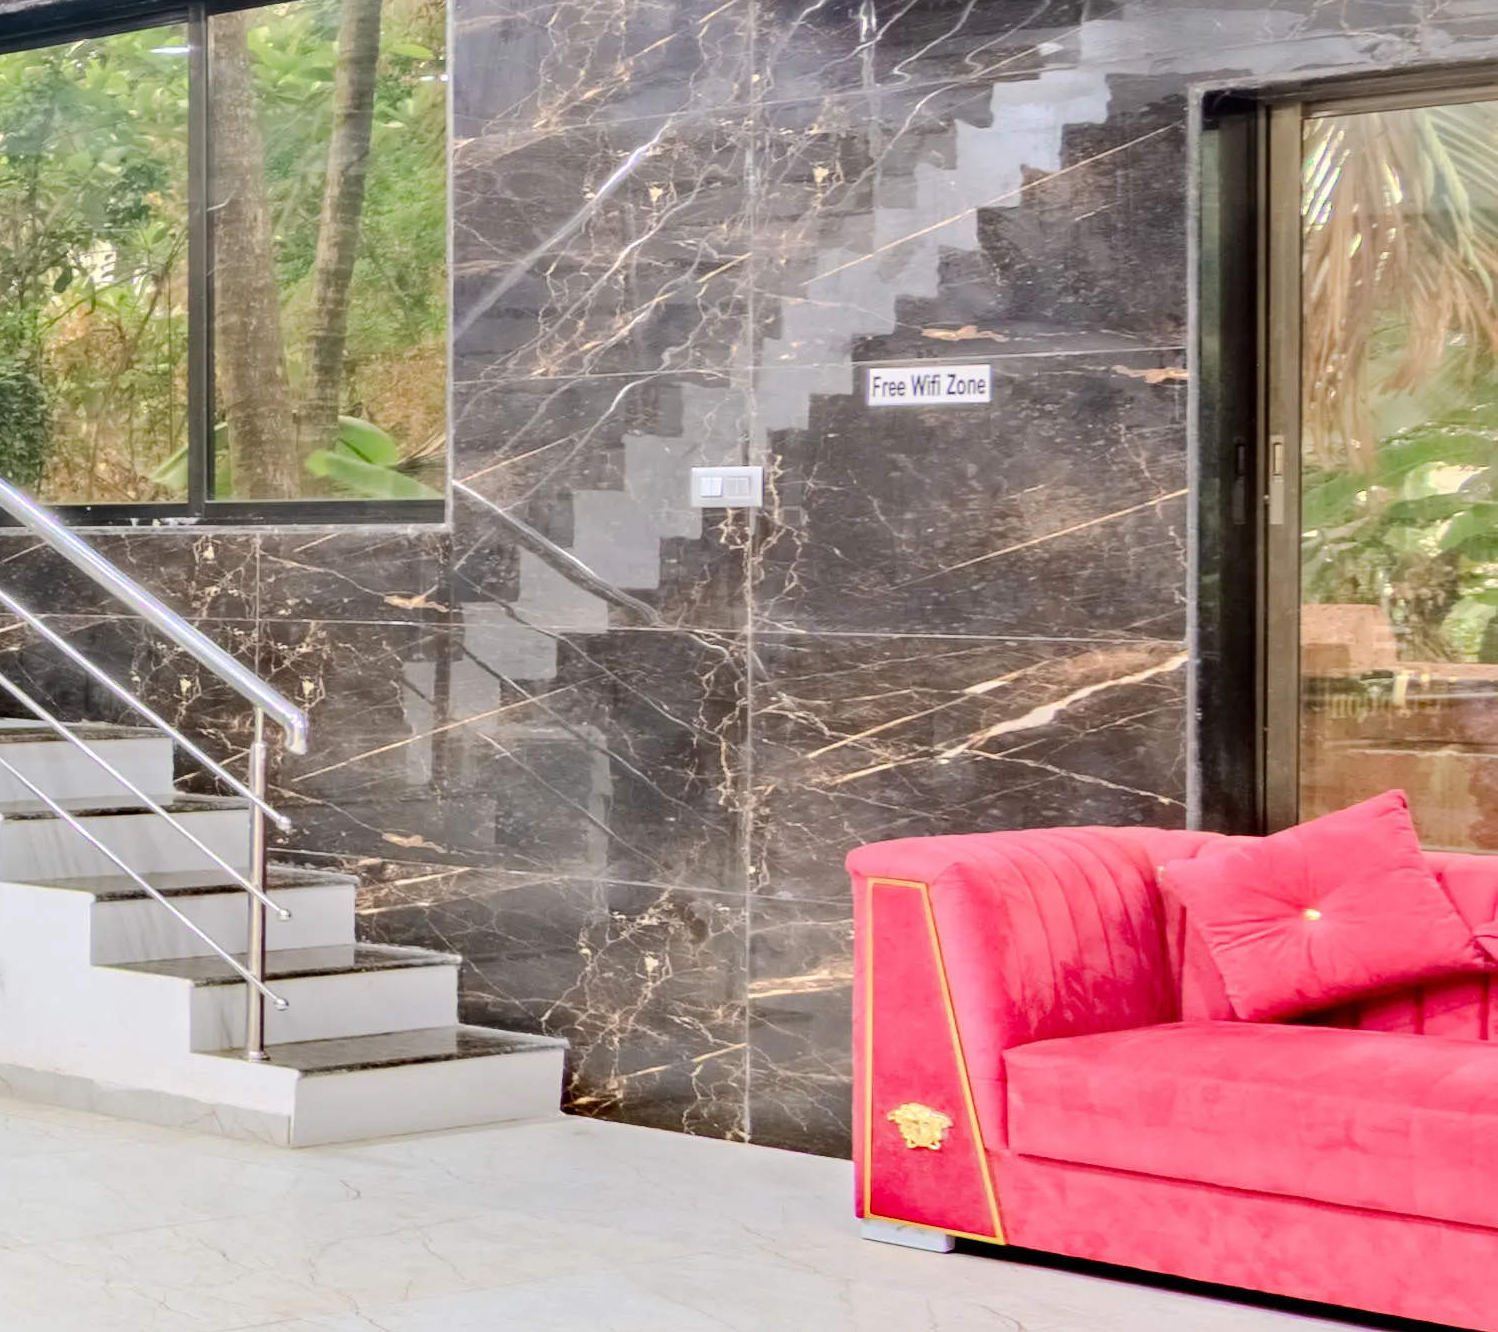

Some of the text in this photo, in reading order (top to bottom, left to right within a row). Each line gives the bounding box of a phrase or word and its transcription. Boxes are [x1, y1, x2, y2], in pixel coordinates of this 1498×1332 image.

[872, 373, 986, 397] Free Wifi Zone
